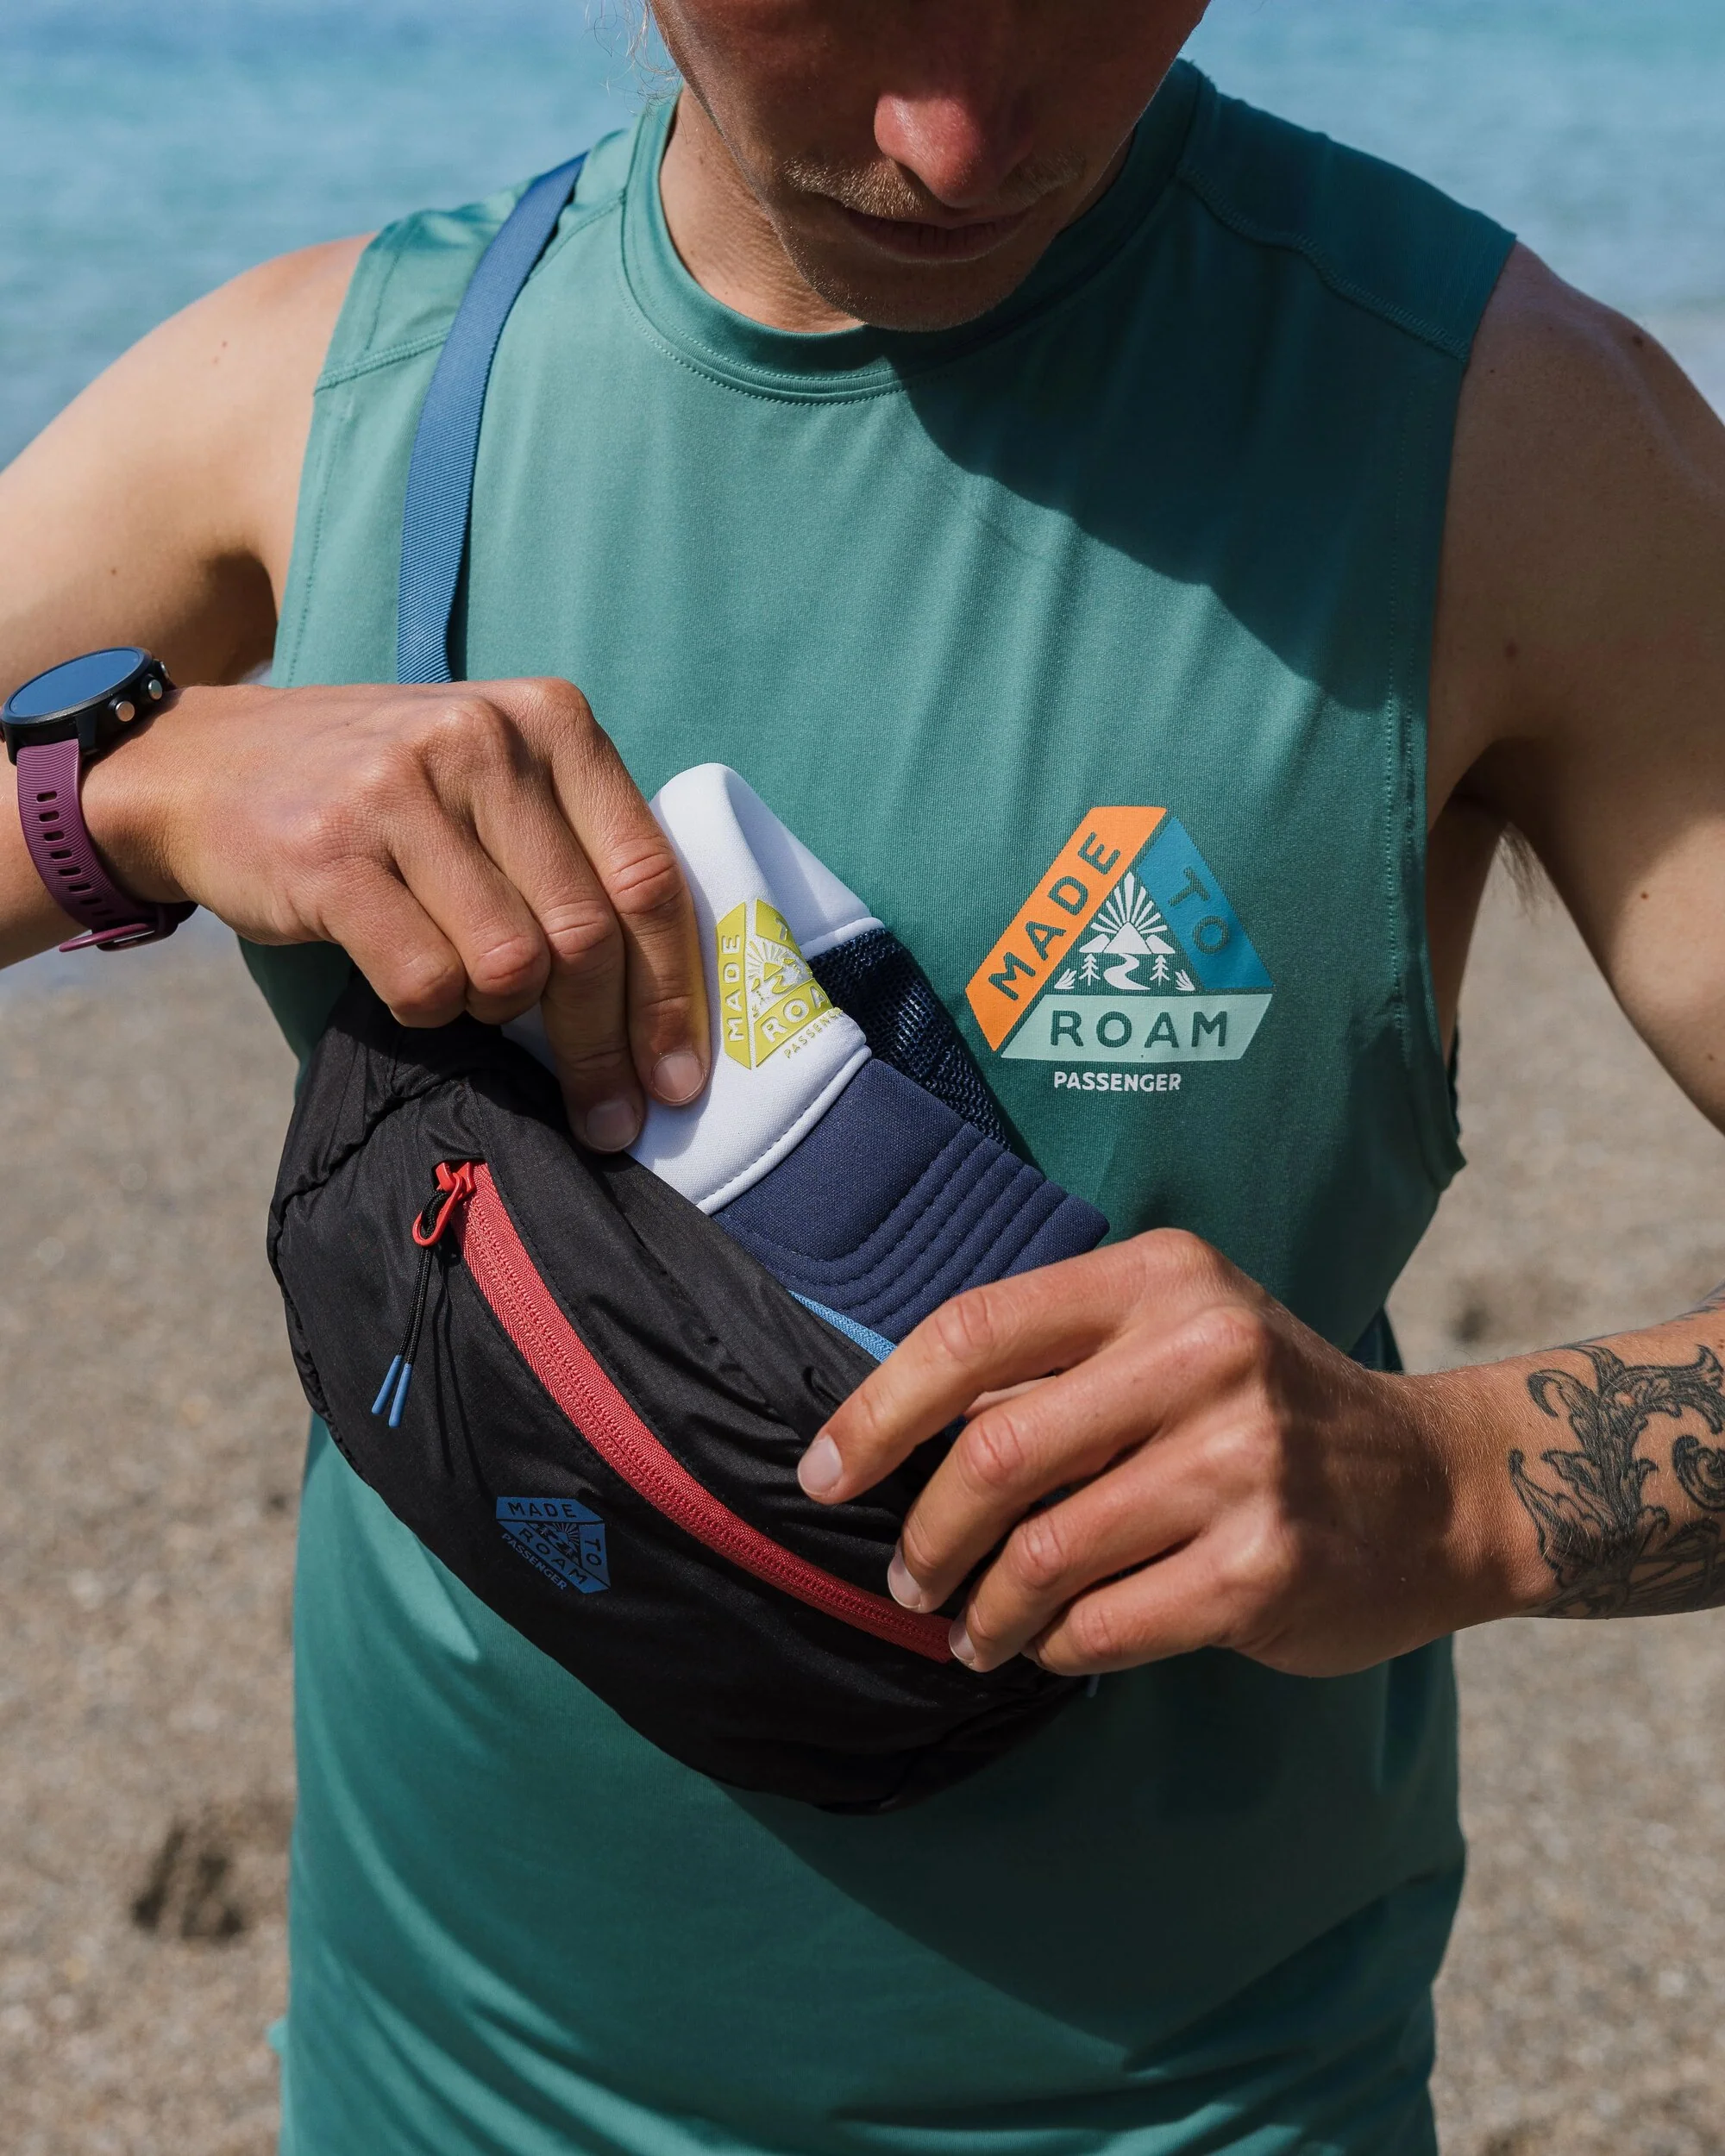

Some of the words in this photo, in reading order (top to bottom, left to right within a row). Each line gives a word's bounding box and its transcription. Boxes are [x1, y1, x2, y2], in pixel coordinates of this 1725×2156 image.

[988, 831, 1121, 1001] MADE
[1169, 868, 1229, 955] TO
[722, 934, 745, 1042] MADE
[760, 986, 829, 1043] ROA
[1050, 1010, 1228, 1049] ROAM
[1054, 1071, 1182, 1093] PASSENGER
[507, 1502, 577, 1519] MADE
[501, 1532, 568, 1590] PASSENGER
[518, 1527, 588, 1584] ROAM
[585, 1539, 602, 1566] TO
